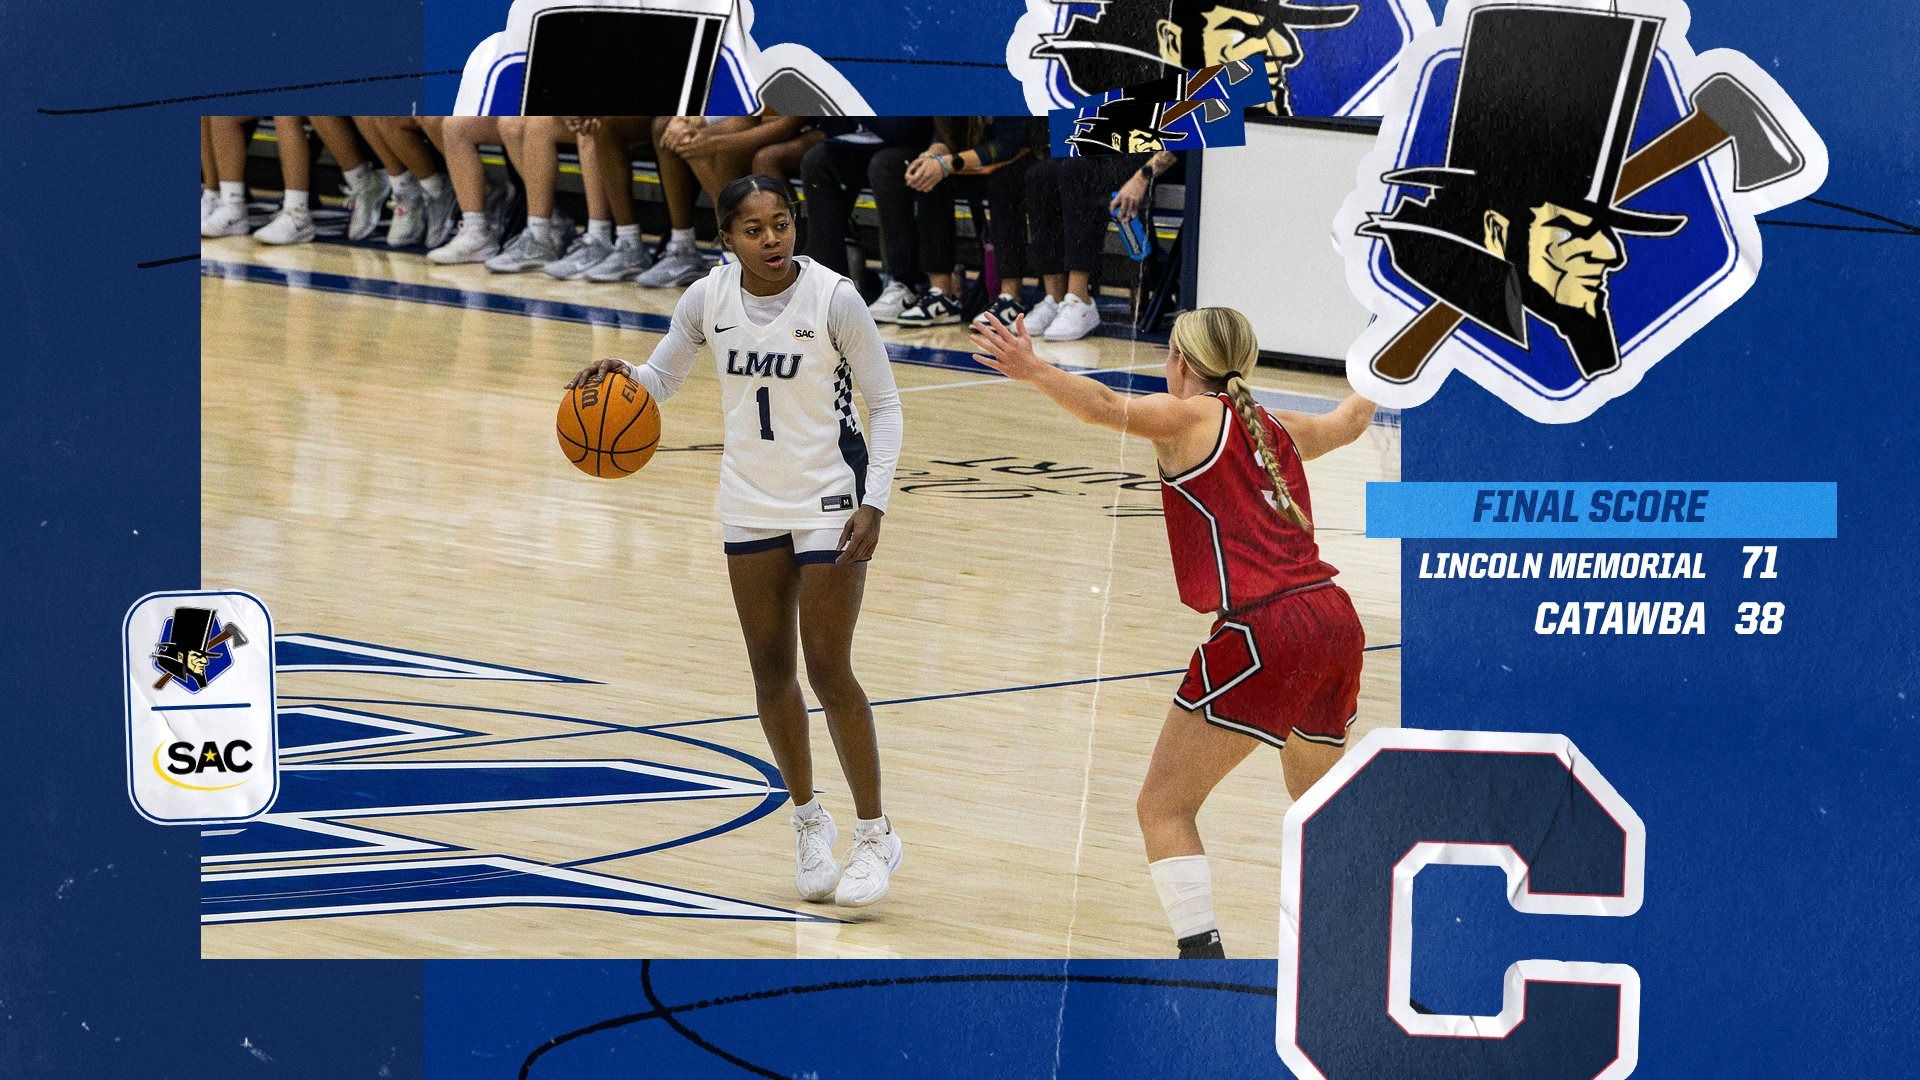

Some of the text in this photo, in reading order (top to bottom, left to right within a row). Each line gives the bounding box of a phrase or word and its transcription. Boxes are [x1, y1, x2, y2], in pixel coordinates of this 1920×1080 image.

[794, 329, 815, 339] SAC
[726, 348, 804, 380] LMU
[756, 386, 775, 441] 1
